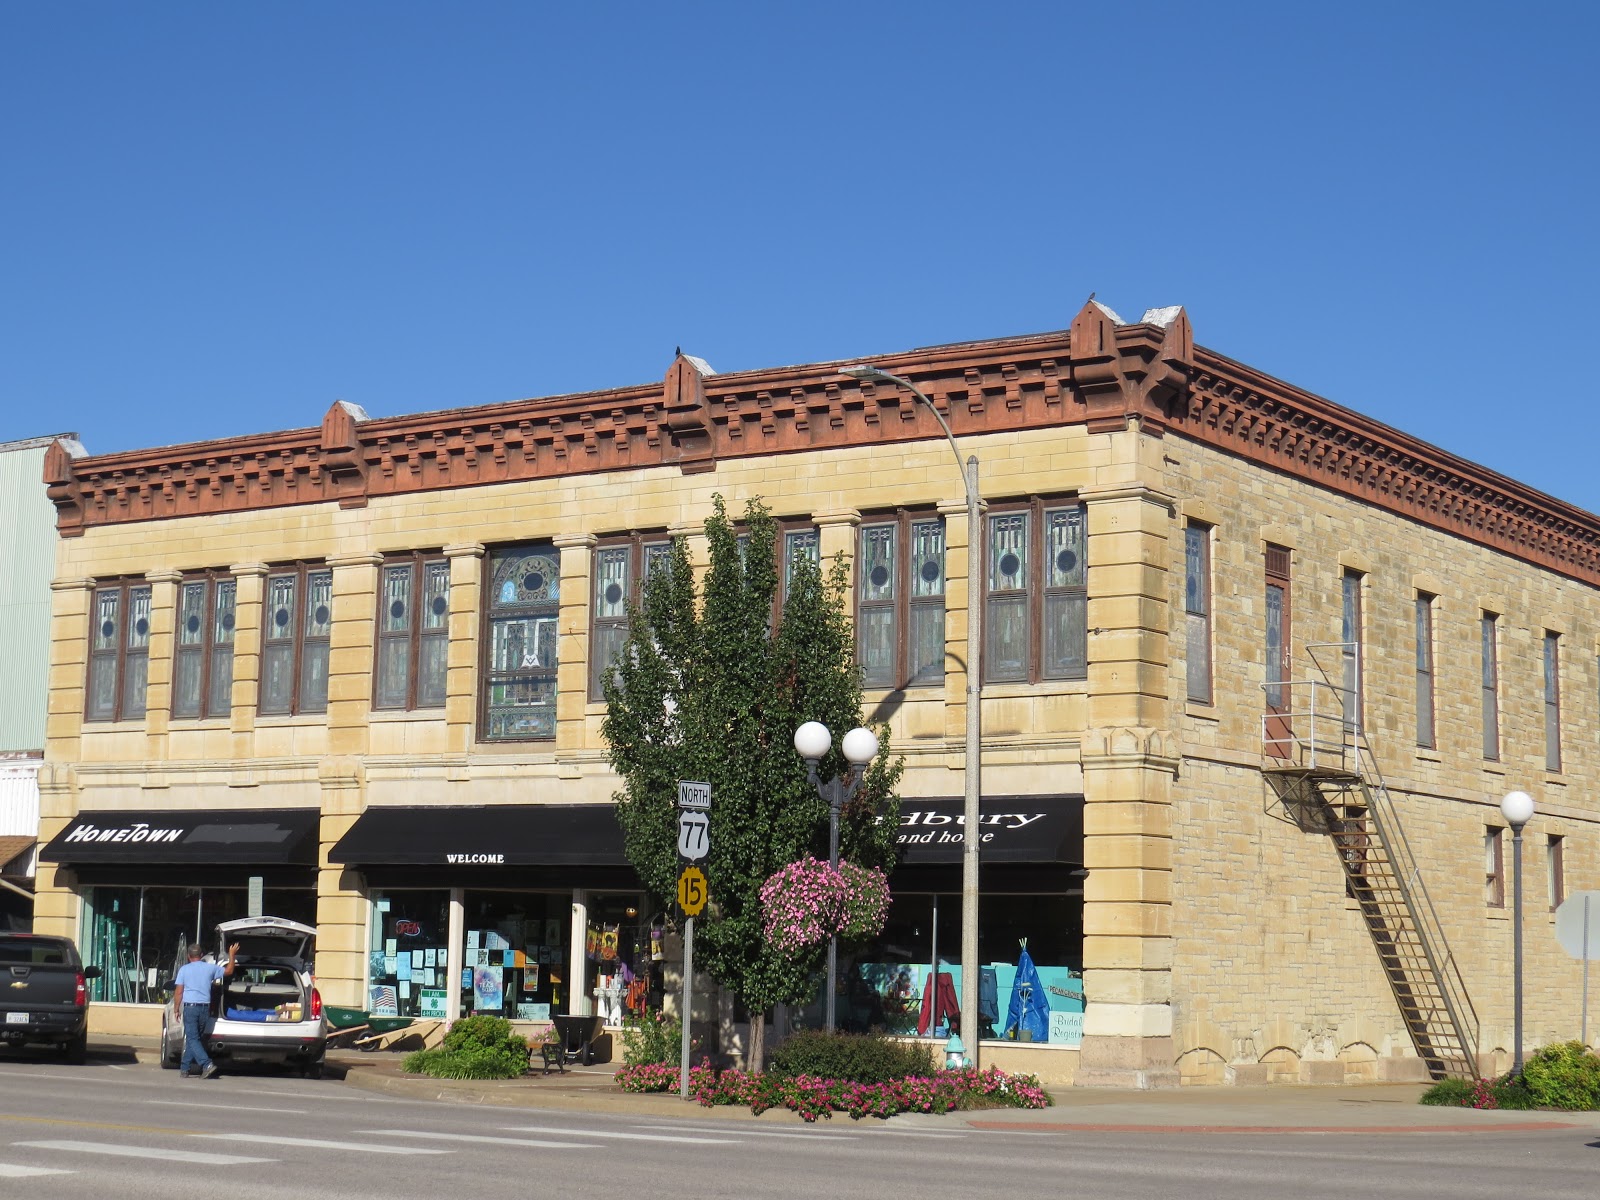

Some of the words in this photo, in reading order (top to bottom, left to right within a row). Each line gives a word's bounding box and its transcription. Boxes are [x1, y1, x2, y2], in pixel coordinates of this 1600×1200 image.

[682, 785, 708, 804] NORTH
[683, 821, 706, 849] 77
[937, 830, 995, 844] hoe
[446, 853, 505, 864] WELCOME
[684, 878, 701, 905] 15
[1054, 1015, 1082, 1026] Bridal
[1051, 1026, 1081, 1041] Registr
